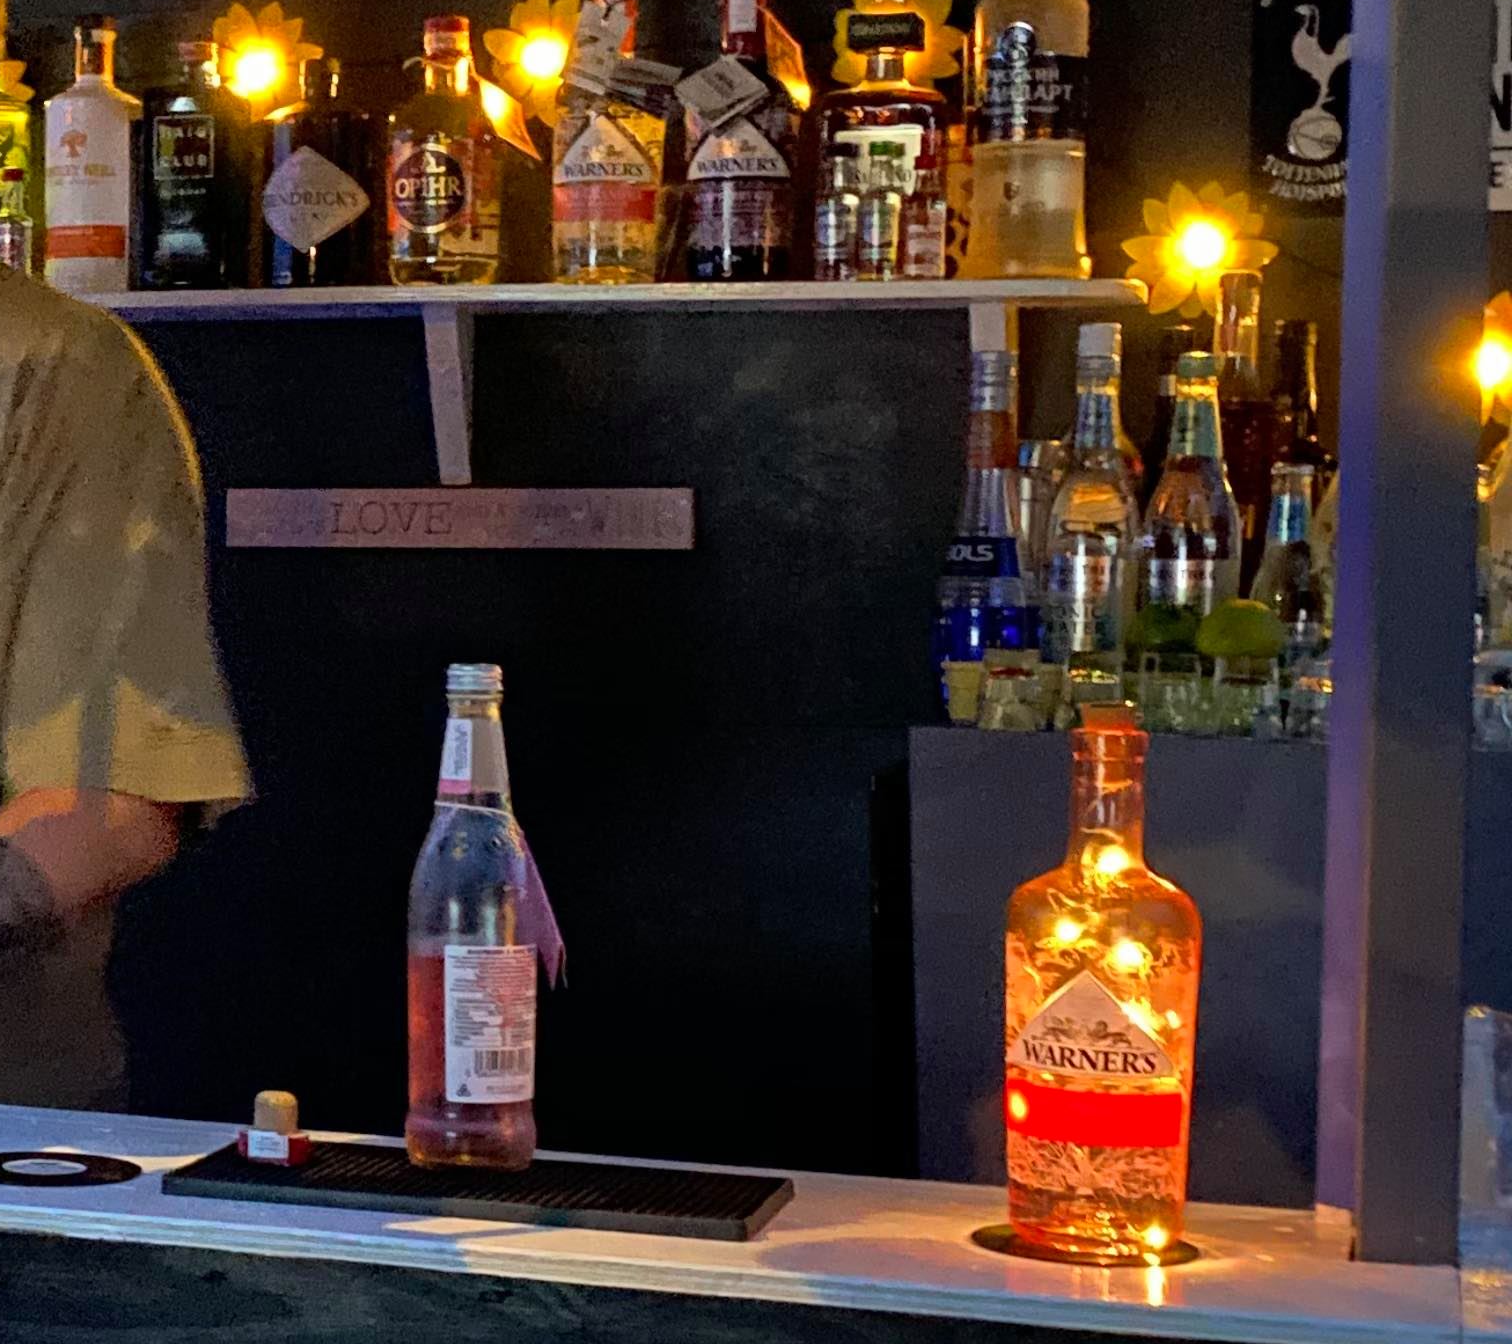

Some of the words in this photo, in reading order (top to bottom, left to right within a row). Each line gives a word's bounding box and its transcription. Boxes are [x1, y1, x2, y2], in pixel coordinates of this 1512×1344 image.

[394, 175, 462, 199] OPIHR
[329, 500, 454, 537] LOVE
[1021, 1039, 1158, 1075] WARNER'S
